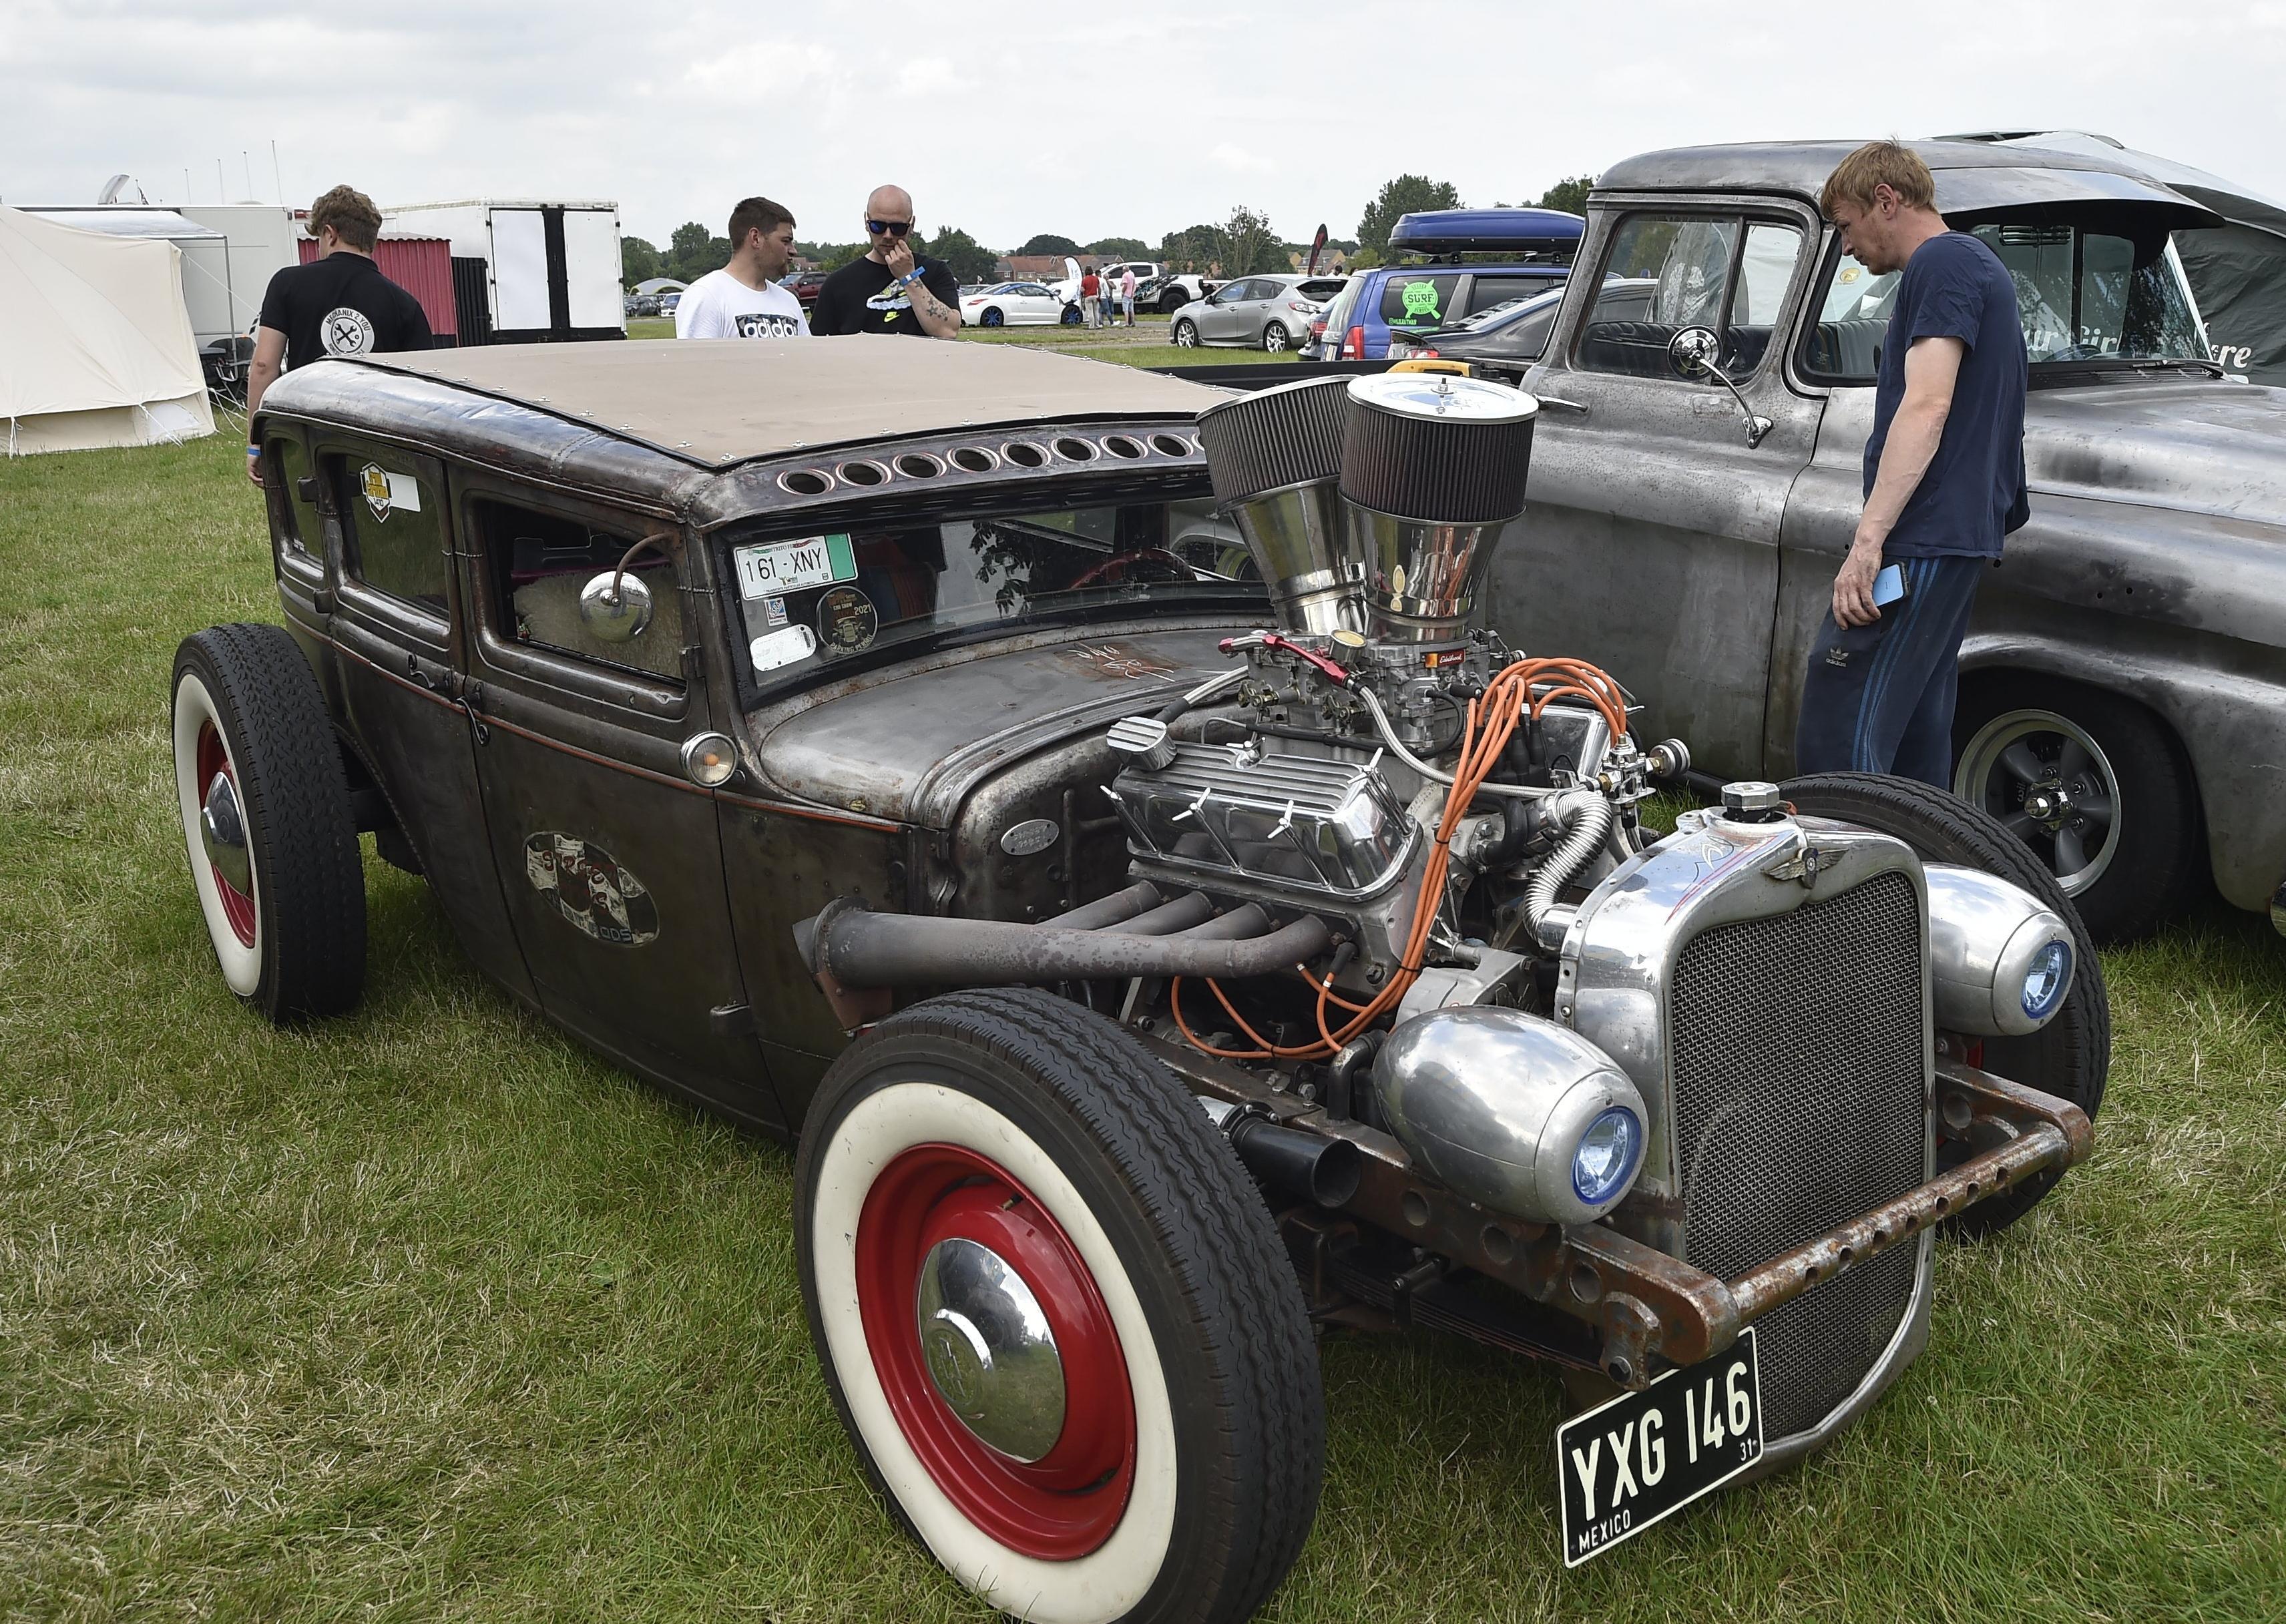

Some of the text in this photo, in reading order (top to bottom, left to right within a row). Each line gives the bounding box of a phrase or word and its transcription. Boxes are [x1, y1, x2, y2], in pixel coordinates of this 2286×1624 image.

[1407, 294, 1433, 303] SURF
[326, 309, 354, 326] MECHANIX
[361, 317, 371, 331] YOU
[854, 603, 872, 615] 2021
[830, 641, 855, 653] PARKING
[1572, 1361, 1751, 1521] YXG 146
[1740, 1438, 1753, 1462] 31
[1578, 1509, 1631, 1555] MEXICO
